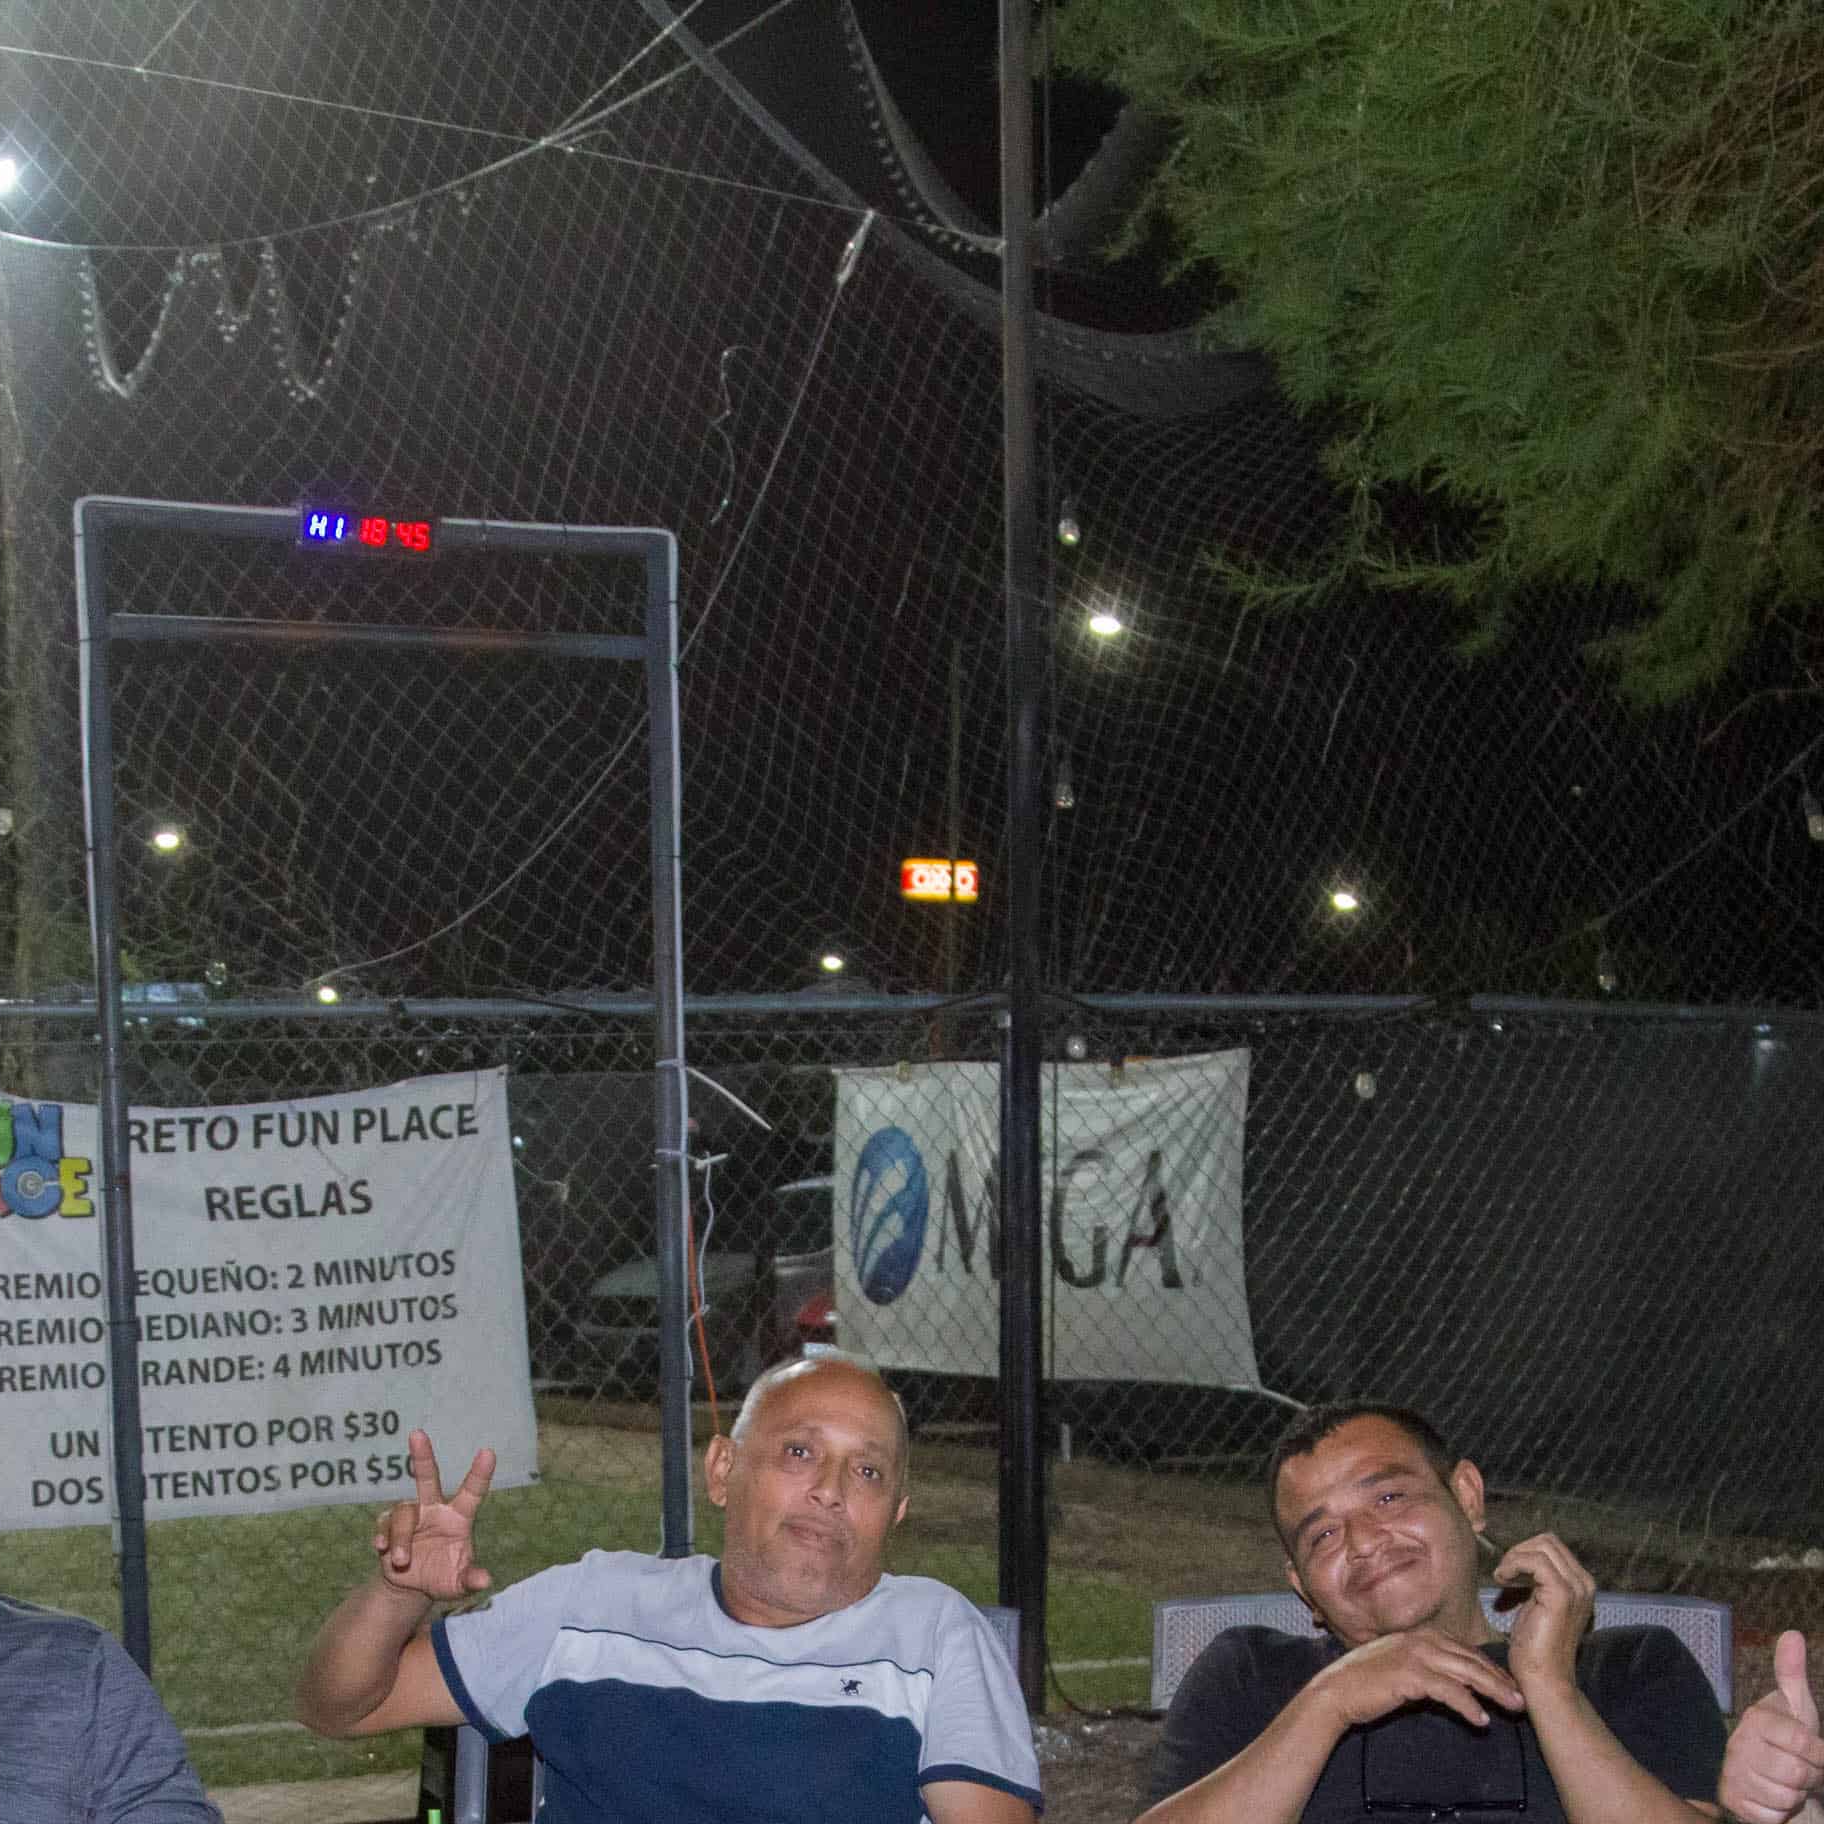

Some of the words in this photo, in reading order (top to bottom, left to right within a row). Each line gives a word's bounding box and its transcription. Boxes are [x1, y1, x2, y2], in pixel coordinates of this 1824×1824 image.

[128, 1114, 239, 1154] RETO
[252, 1109, 340, 1150] FUN
[353, 1103, 479, 1145] PLACE
[204, 1179, 373, 1222] REGLAS
[133, 1259, 279, 1299] EQUEÑO:
[286, 1264, 306, 1289] 2
[314, 1250, 456, 1287] MINUTOS
[134, 1309, 283, 1343] EDIANO:
[291, 1307, 308, 1333] 3
[318, 1293, 458, 1331] MINUTOS
[141, 1354, 265, 1387] RANDE:
[272, 1353, 291, 1378] 4
[300, 1339, 443, 1377] MINUTOS
[50, 1429, 101, 1459] UN
[145, 1421, 258, 1454] TENTO
[267, 1415, 334, 1446] POR
[344, 1409, 400, 1442] $30
[31, 1476, 105, 1507] DOS
[145, 1464, 281, 1501] TENTOS
[290, 1458, 358, 1489] POR
